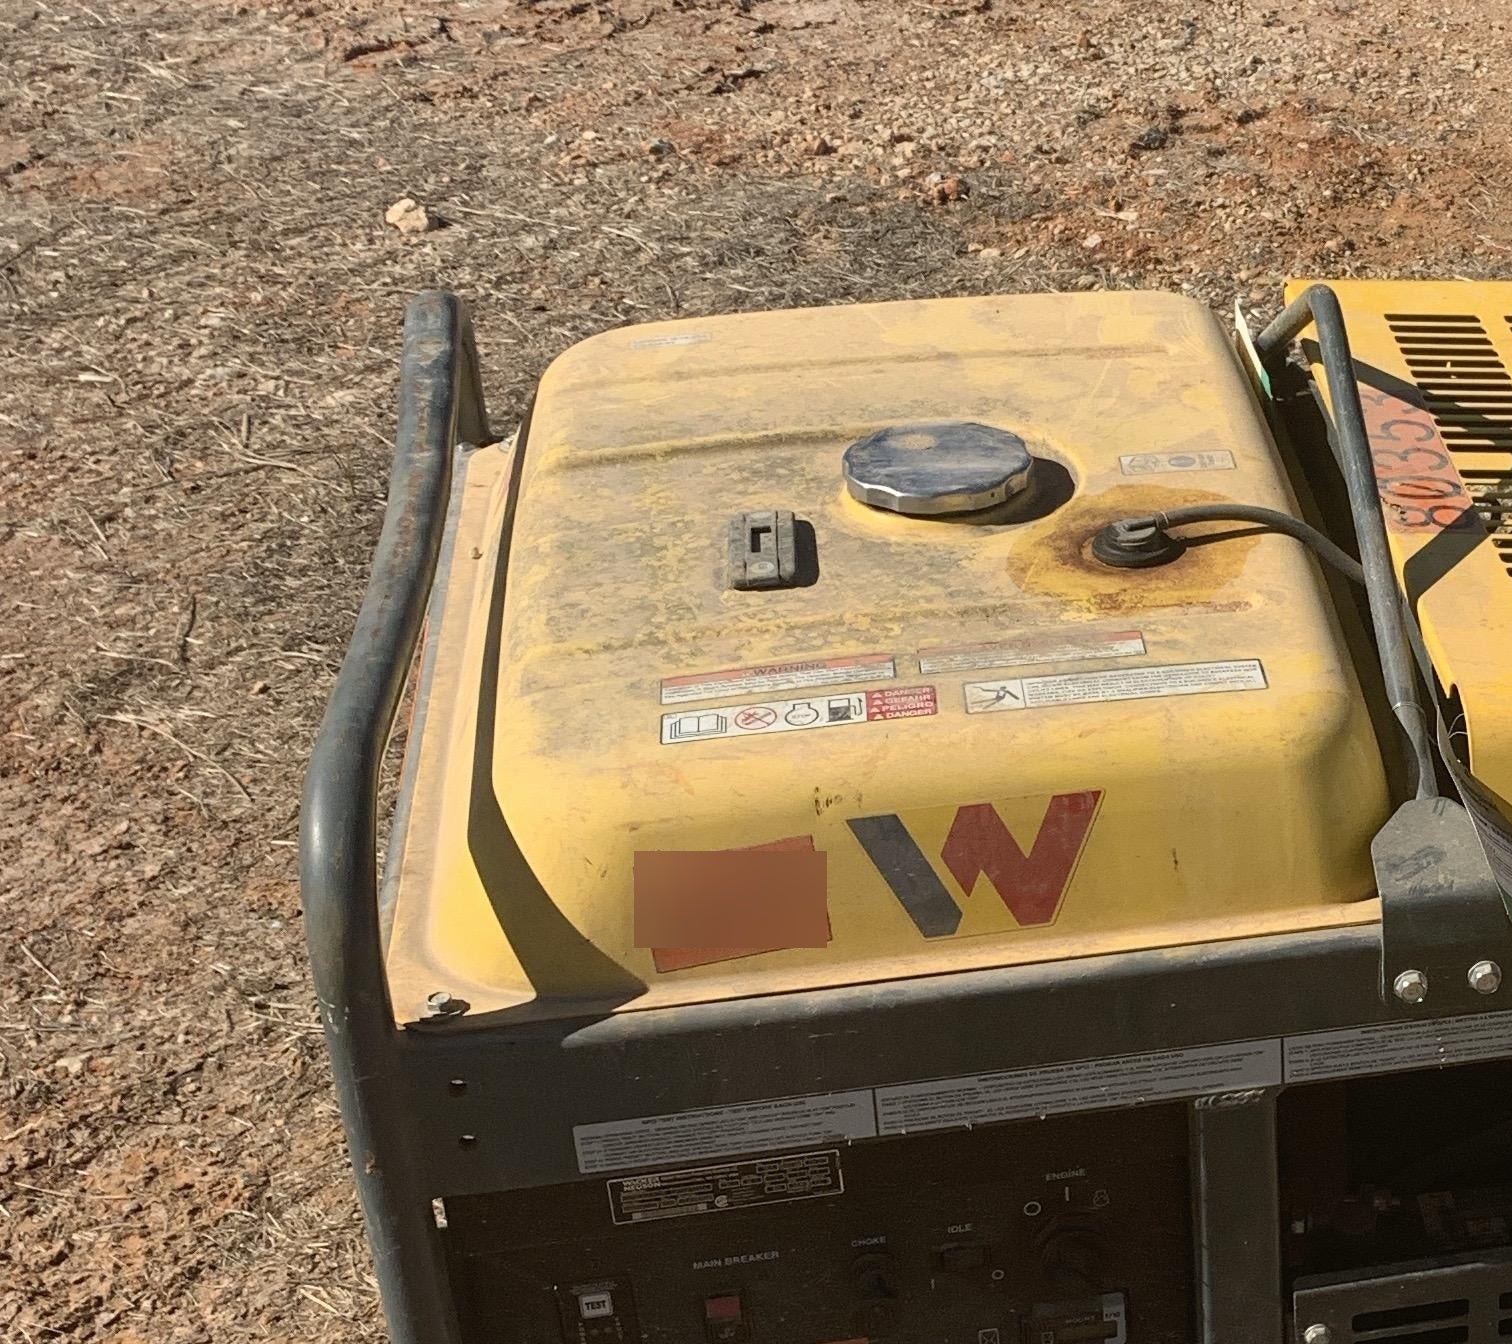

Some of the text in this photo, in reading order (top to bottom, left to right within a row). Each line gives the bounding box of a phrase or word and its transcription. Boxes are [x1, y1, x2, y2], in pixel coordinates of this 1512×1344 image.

[752, 662, 826, 677] WARNING
[884, 687, 930, 697] DANGER
[884, 694, 932, 705] GEFAHR
[880, 701, 934, 712] PELIGRO
[884, 708, 932, 719] DANGER
[1045, 1167, 1087, 1182] ENGINE
[948, 1223, 974, 1235] IDLE
[851, 1235, 887, 1248] CHOKE
[692, 1251, 779, 1271] MAIN BREAKER
[585, 1300, 607, 1311] TEST
